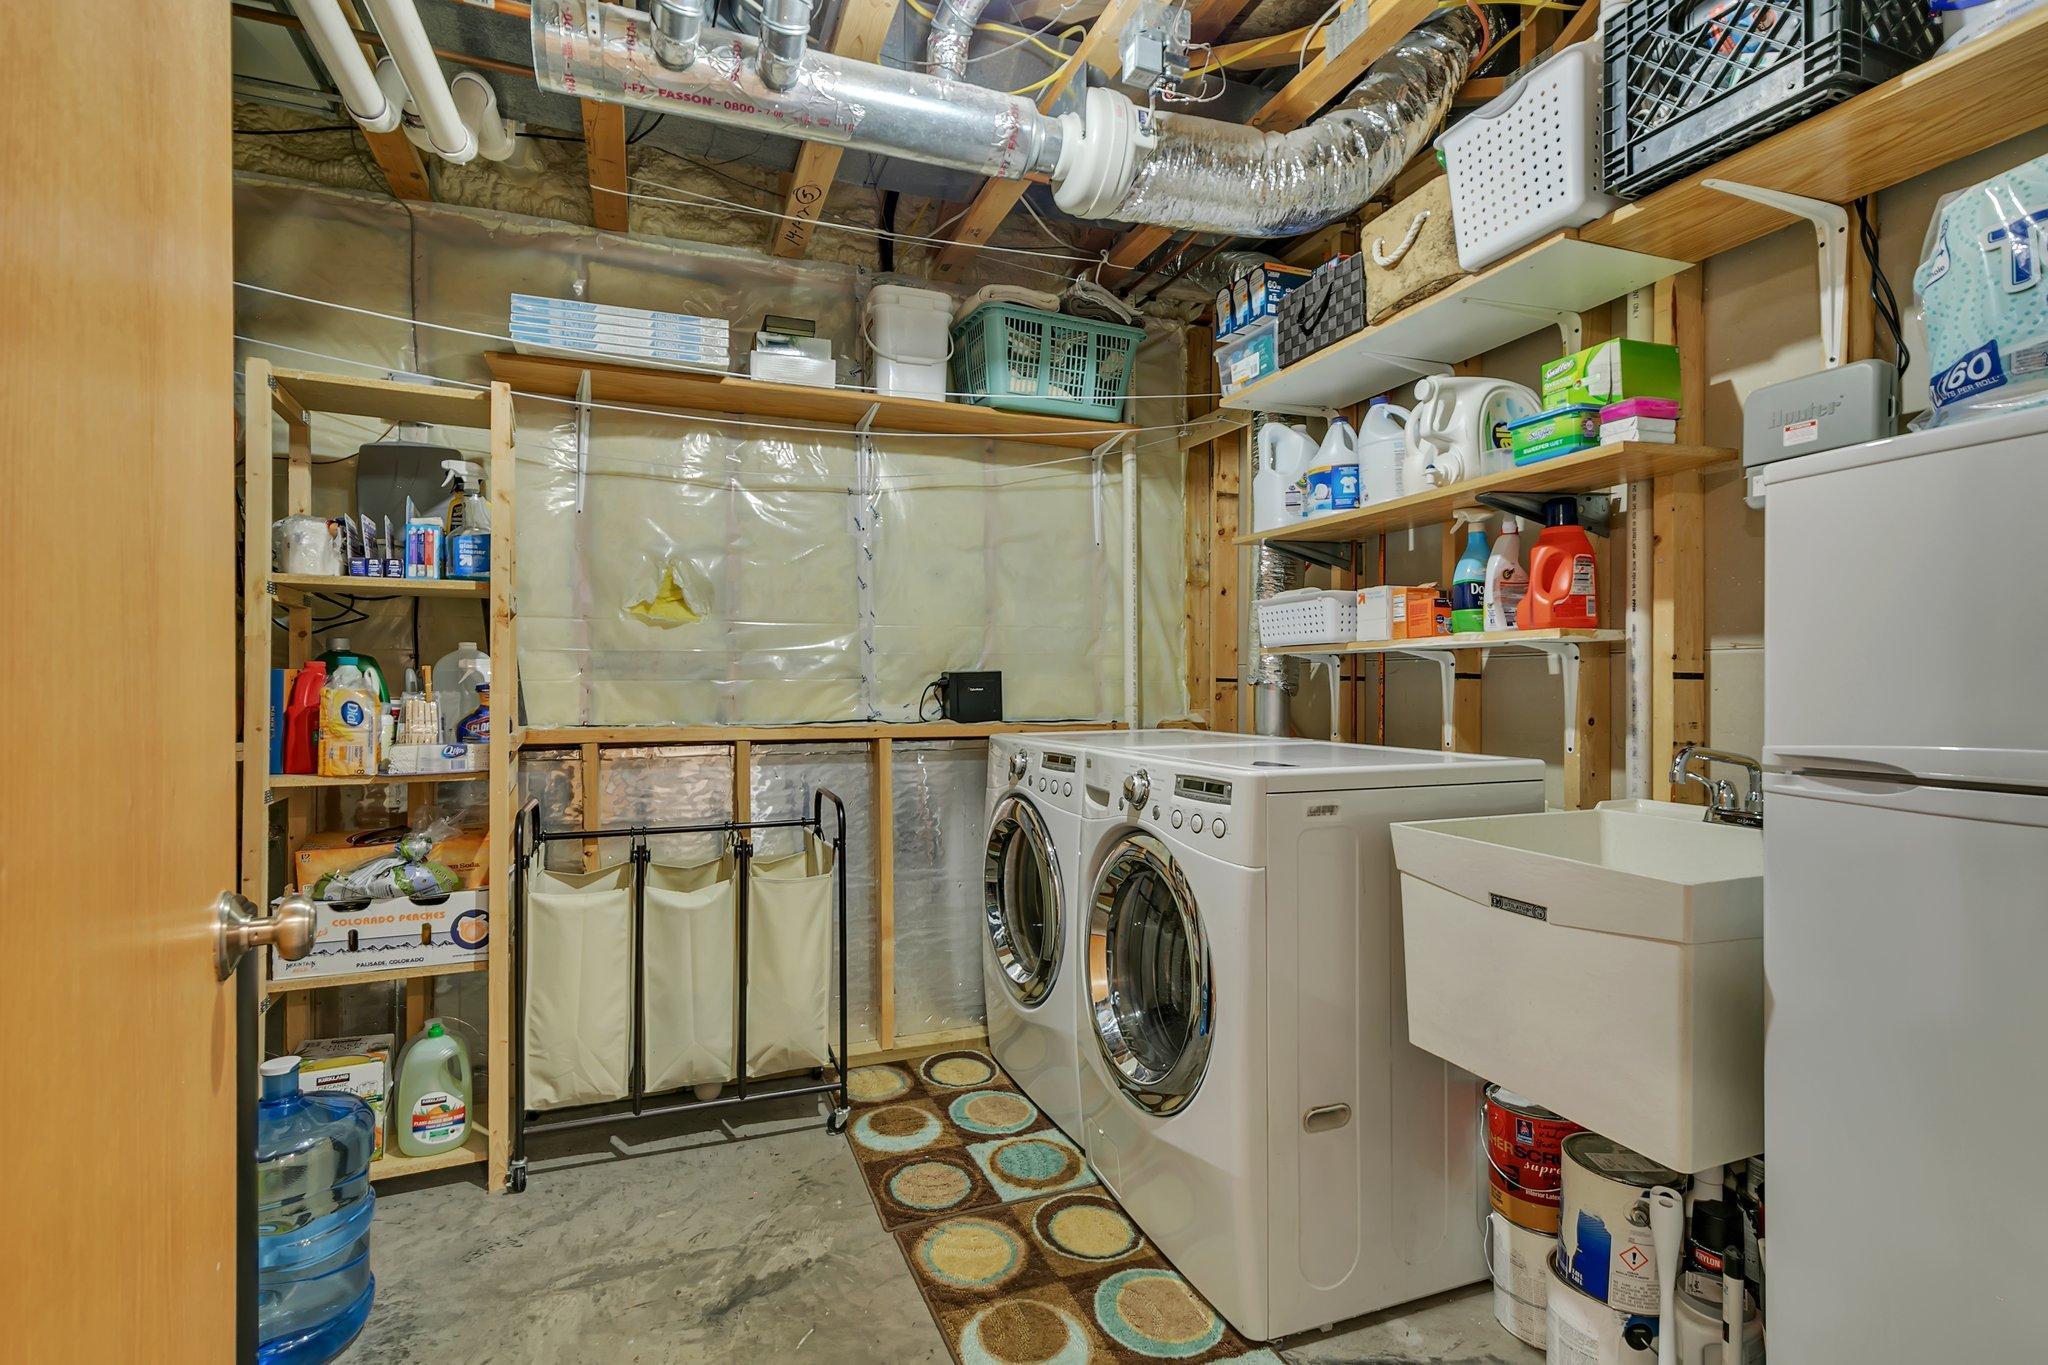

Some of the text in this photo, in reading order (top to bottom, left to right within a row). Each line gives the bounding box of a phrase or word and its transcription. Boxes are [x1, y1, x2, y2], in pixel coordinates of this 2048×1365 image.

[657, 87, 714, 107] FASSON
[723, 101, 755, 115] 0800
[1956, 382, 1975, 396] PER
[346, 703, 360, 726] Dial
[459, 861, 481, 869] Soda
[332, 911, 446, 928] COLORADO PEACHES
[388, 956, 425, 965] COLORADO
